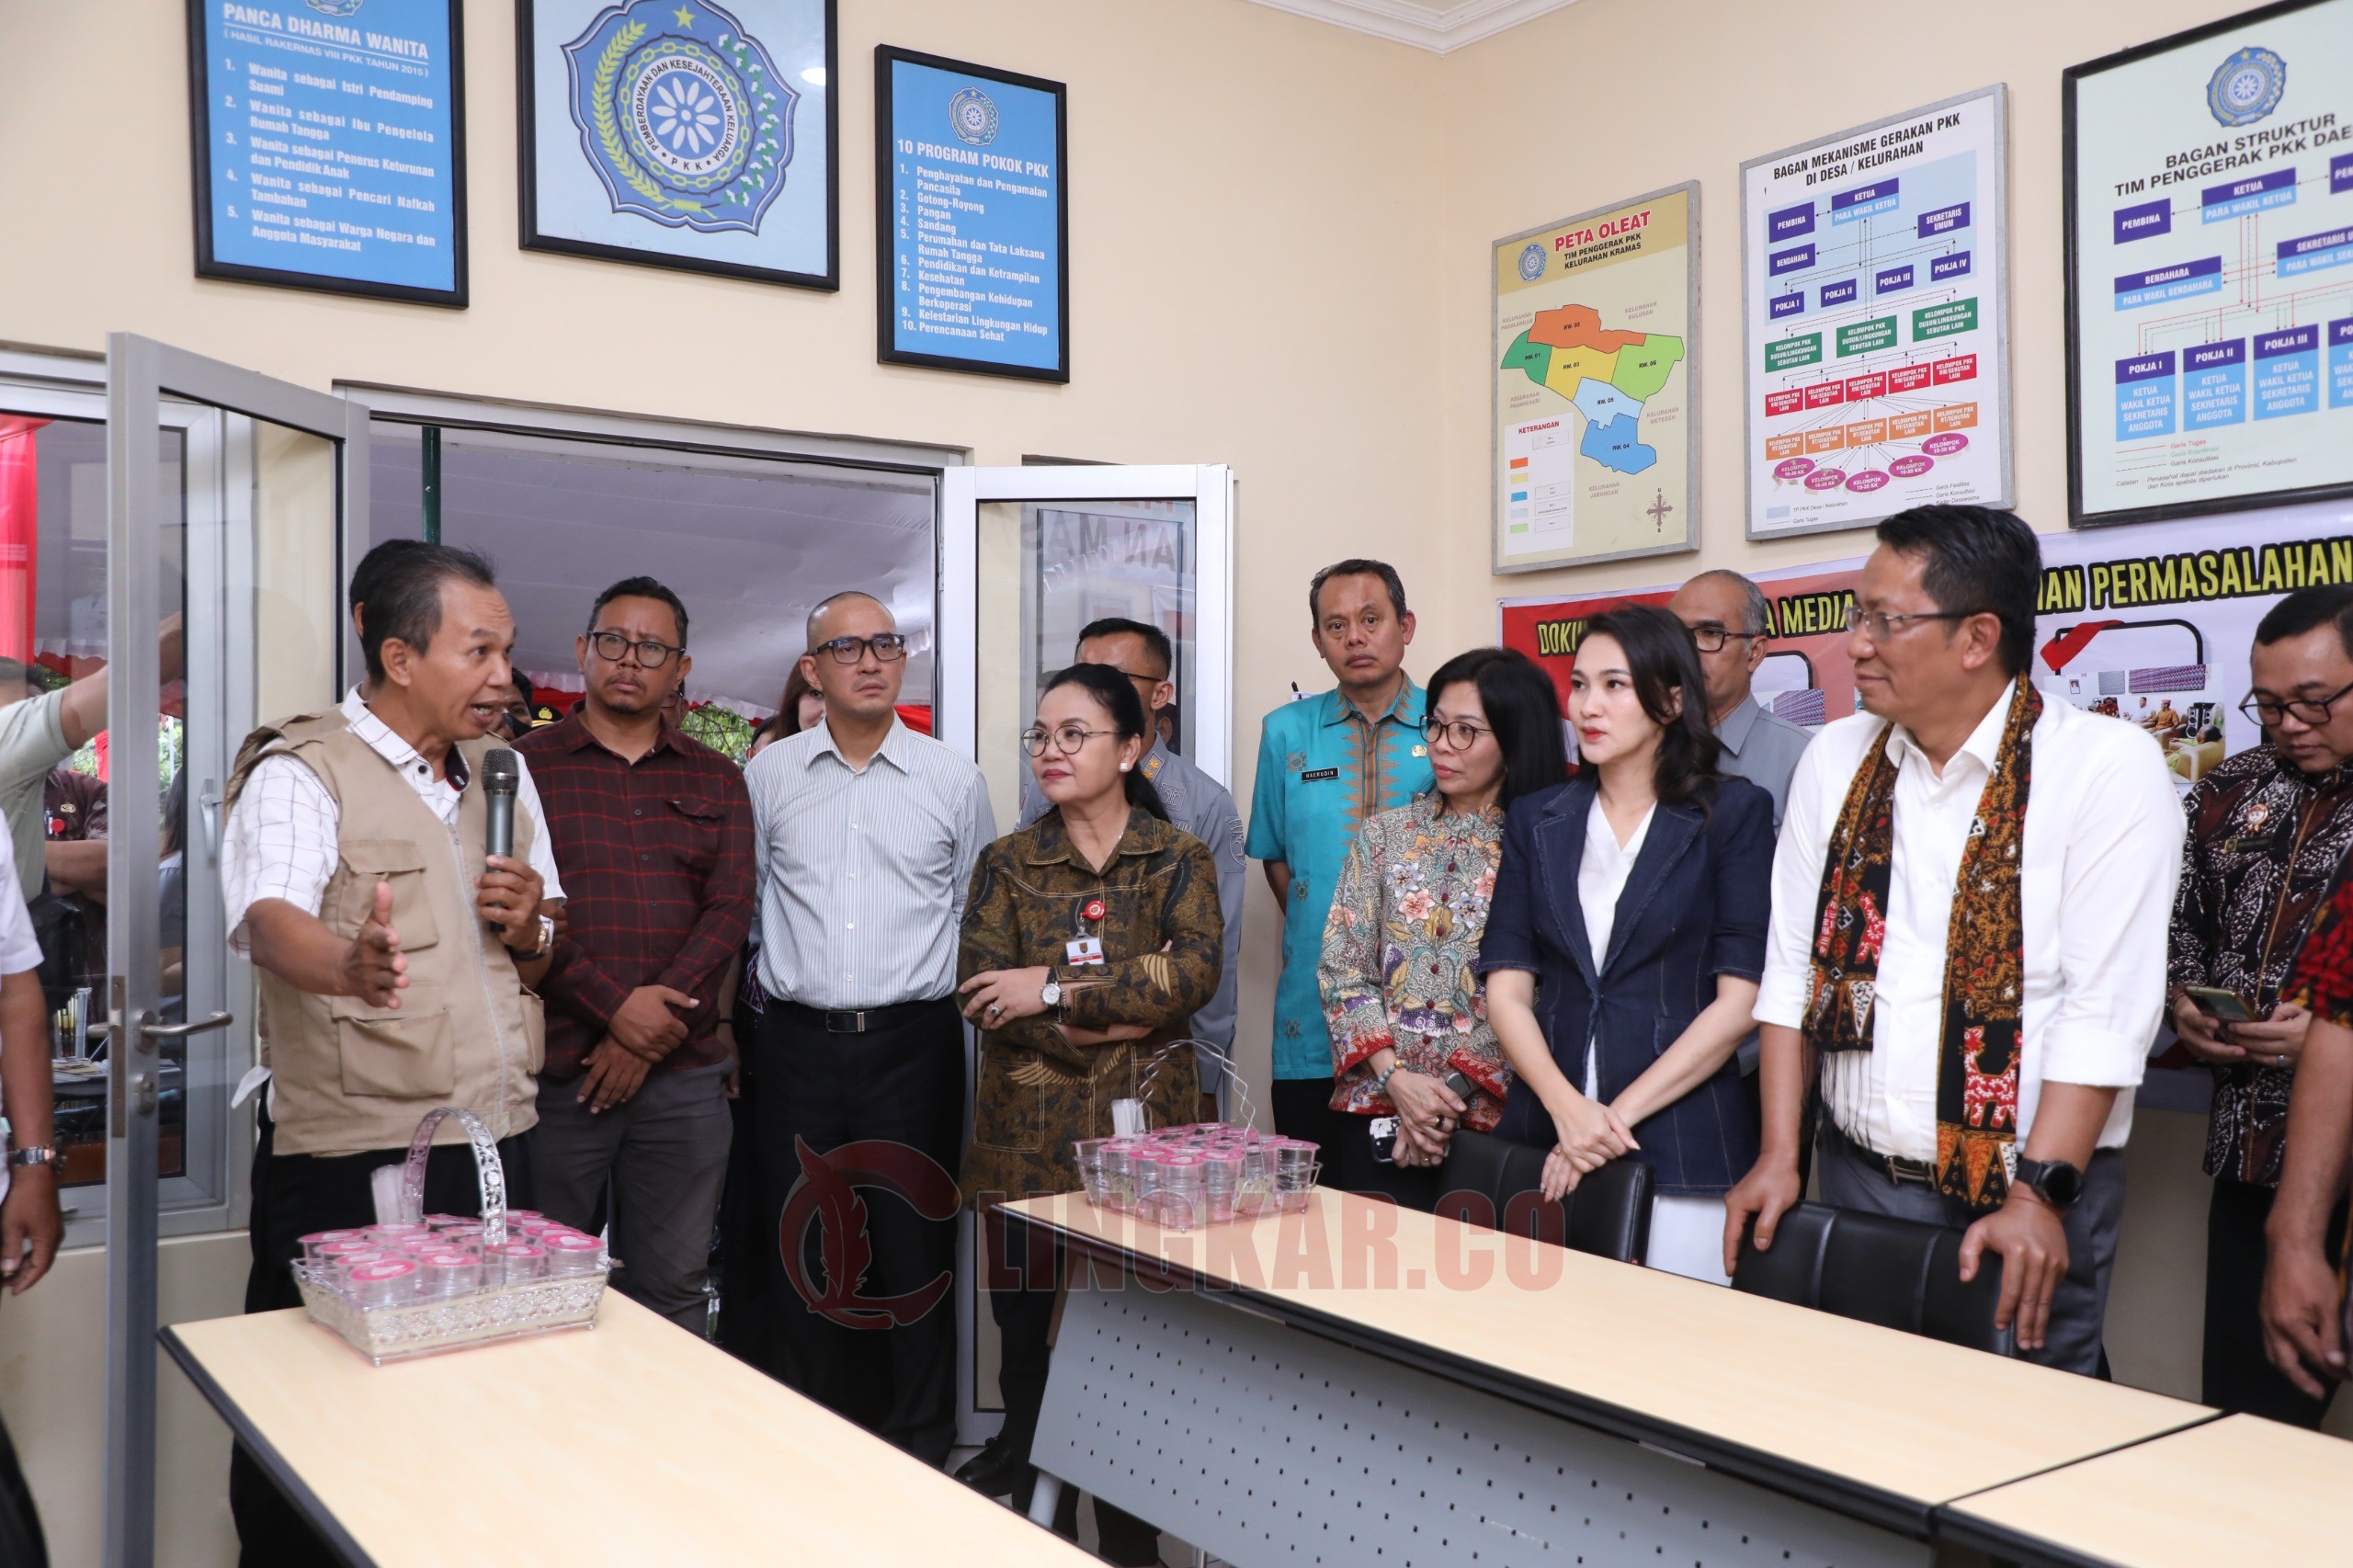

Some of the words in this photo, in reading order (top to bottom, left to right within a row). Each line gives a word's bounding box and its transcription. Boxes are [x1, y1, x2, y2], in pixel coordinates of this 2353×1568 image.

[224, 3, 282, 30] PANCA
[288, 17, 361, 46] DHARMA
[367, 32, 428, 59] WANITA
[231, 31, 263, 45] HASIL
[265, 38, 322, 56] RAKERNAS
[324, 50, 340, 60] VIII
[342, 52, 363, 64] PKK
[366, 57, 399, 72] TAHUN
[401, 64, 424, 76] 2015
[225, 58, 235, 71] 1.
[249, 62, 288, 81] Wanita
[294, 74, 336, 90] sebagai
[342, 81, 364, 95] Istri
[249, 79, 284, 96] Suami
[225, 95, 236, 108] 2.
[250, 100, 292, 118] Wanita
[299, 110, 346, 127] sebagai
[352, 118, 370, 131] Ibu
[377, 122, 434, 142] Pengelola
[636, 74, 659, 151] PEMBERDAYAAN
[651, 62, 668, 77] DAN
[670, 60, 733, 112] KESEJAHTERAAN
[713, 115, 734, 162] KELUARGA
[250, 116, 289, 133] Rumah
[291, 123, 330, 141] Tangga
[1774, 159, 1808, 180] BAGAN
[1812, 138, 1877, 169] MEKANISME
[1881, 121, 1933, 148] GERAKAN
[1938, 112, 1961, 131] PKK
[2166, 142, 2228, 169] BAGAN
[2234, 114, 2335, 151] STRUKTUR
[226, 132, 237, 144] 3.
[251, 136, 289, 153] Wanita
[292, 145, 334, 161] sebagai
[336, 151, 380, 168] Penerus
[382, 159, 435, 177] Keturunan
[251, 153, 272, 166] dan
[274, 156, 322, 175] Pendidik
[323, 165, 349, 179] Anak
[898, 139, 914, 154] 10
[917, 142, 979, 166] PROGRAM
[983, 153, 1022, 174] POKOK
[1026, 162, 1049, 178] PKK
[1806, 172, 1816, 187] DI
[1820, 164, 1847, 182] DESA
[1850, 160, 1855, 175] /
[1858, 141, 1923, 171] KELURAHAN
[2114, 178, 2144, 197] TIM
[2151, 149, 2262, 188] PENGGERAK
[2269, 138, 2306, 158] PKK
[227, 169, 238, 181] 4.
[251, 173, 291, 189] Wanita
[298, 182, 342, 198] sebagai
[348, 188, 392, 205] Pencari
[397, 196, 435, 212] Nafkah
[900, 164, 909, 175] 1.
[917, 166, 974, 186] Penghayatan
[977, 176, 994, 188] dan
[995, 179, 1048, 198] Pengamalan
[917, 179, 961, 196] Pancasila
[2234, 180, 2263, 196] KETUA
[252, 188, 307, 208] Tambahan
[900, 189, 909, 200] 2.
[917, 192, 984, 215] Gotong-Royong
[1855, 188, 1875, 201] KETUA
[900, 202, 909, 213] 3.
[917, 205, 951, 221] Pangan
[1778, 216, 1806, 230] PEMBINA
[1835, 210, 1852, 222] PARA
[1853, 204, 1873, 217] WAKIL
[1875, 199, 1896, 210] KETUA
[2122, 213, 2161, 230] PEMBINA
[227, 205, 238, 218] 5.
[252, 210, 290, 225] Wanita
[294, 217, 335, 232] sebagai
[338, 222, 373, 238] Warga
[376, 228, 414, 244] Negara
[416, 234, 436, 246] dan
[253, 225, 297, 243] Anggota
[900, 216, 909, 226] 4.
[918, 218, 957, 236] Sandang
[1555, 229, 1594, 251] PETA
[1598, 210, 1650, 239] OLEAT
[1934, 219, 1954, 231] UMUM
[901, 228, 909, 240] 5.
[918, 231, 968, 248] Perumahan
[971, 239, 987, 251] dan
[989, 242, 1007, 255] Tata
[1010, 245, 1045, 260] Laksana
[918, 244, 949, 258] Rumah
[951, 248, 983, 265] Tangga
[1564, 251, 1577, 260] TIM
[1579, 237, 1624, 256] PENGGERAK
[1625, 233, 1642, 244] PKK
[1564, 251, 1608, 269] KELURAHAN
[1609, 242, 1642, 257] KRAMAS
[901, 255, 910, 266] 6.
[918, 256, 968, 273] Pendidikan
[970, 265, 986, 276] dan
[989, 267, 1040, 284] Ketrampilan
[1777, 253, 1808, 267] BENDAHARA
[1935, 261, 1958, 274] POKJA
[1959, 258, 1967, 268] IV
[902, 267, 911, 278] 7.
[918, 270, 965, 286] Kesehatan
[1880, 275, 1902, 287] POKJA
[1903, 272, 1911, 281] III
[2145, 267, 2189, 285] BENDAHARA
[902, 280, 910, 291] 8.
[918, 283, 986, 302] Pengembangan
[988, 292, 1033, 308] Kehidupan
[919, 295, 972, 312] Berkoperasi
[1775, 301, 1795, 312] POKJA
[1796, 299, 1800, 307] I
[1825, 288, 1846, 300] POKJA
[1847, 287, 1852, 295] II
[902, 306, 911, 317] 9.
[919, 309, 969, 324] Kelestarian
[972, 315, 1021, 332] Lingkungan
[1023, 322, 1048, 336] Hidup
[903, 320, 916, 331] 10.
[919, 321, 977, 338] Perencanaan
[980, 329, 1005, 342] Sehat
[1518, 421, 1560, 434] KETERANGAN
[1538, 620, 1588, 654] DOKU
[2093, 540, 2353, 606] PERMASALAHAN
